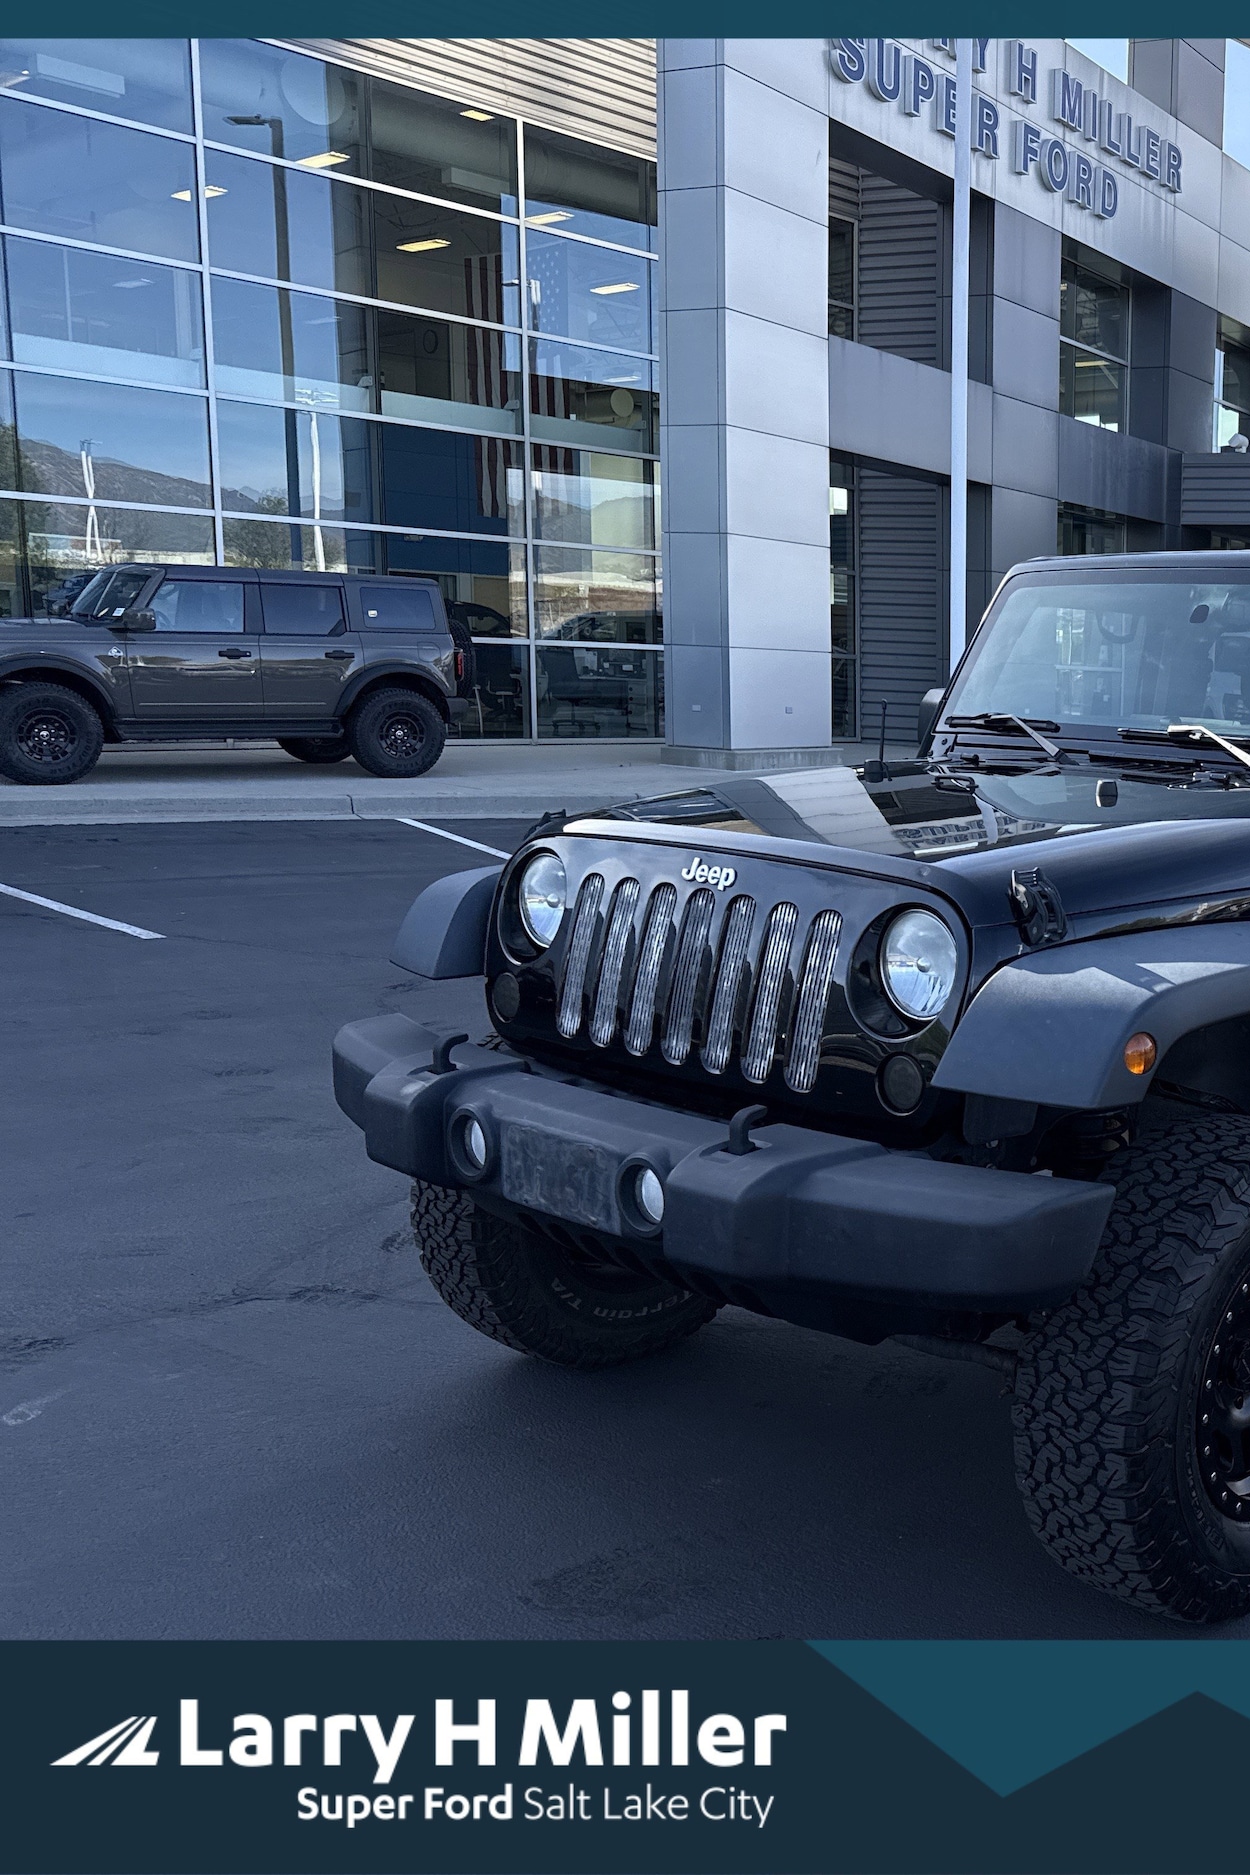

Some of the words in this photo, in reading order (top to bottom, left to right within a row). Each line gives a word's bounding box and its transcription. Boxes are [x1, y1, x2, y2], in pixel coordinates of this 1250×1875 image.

[1010, 39, 1038, 104] H
[1052, 67, 1183, 194] MILLER
[1015, 118, 1119, 220] FORD
[681, 856, 738, 892] Jeep
